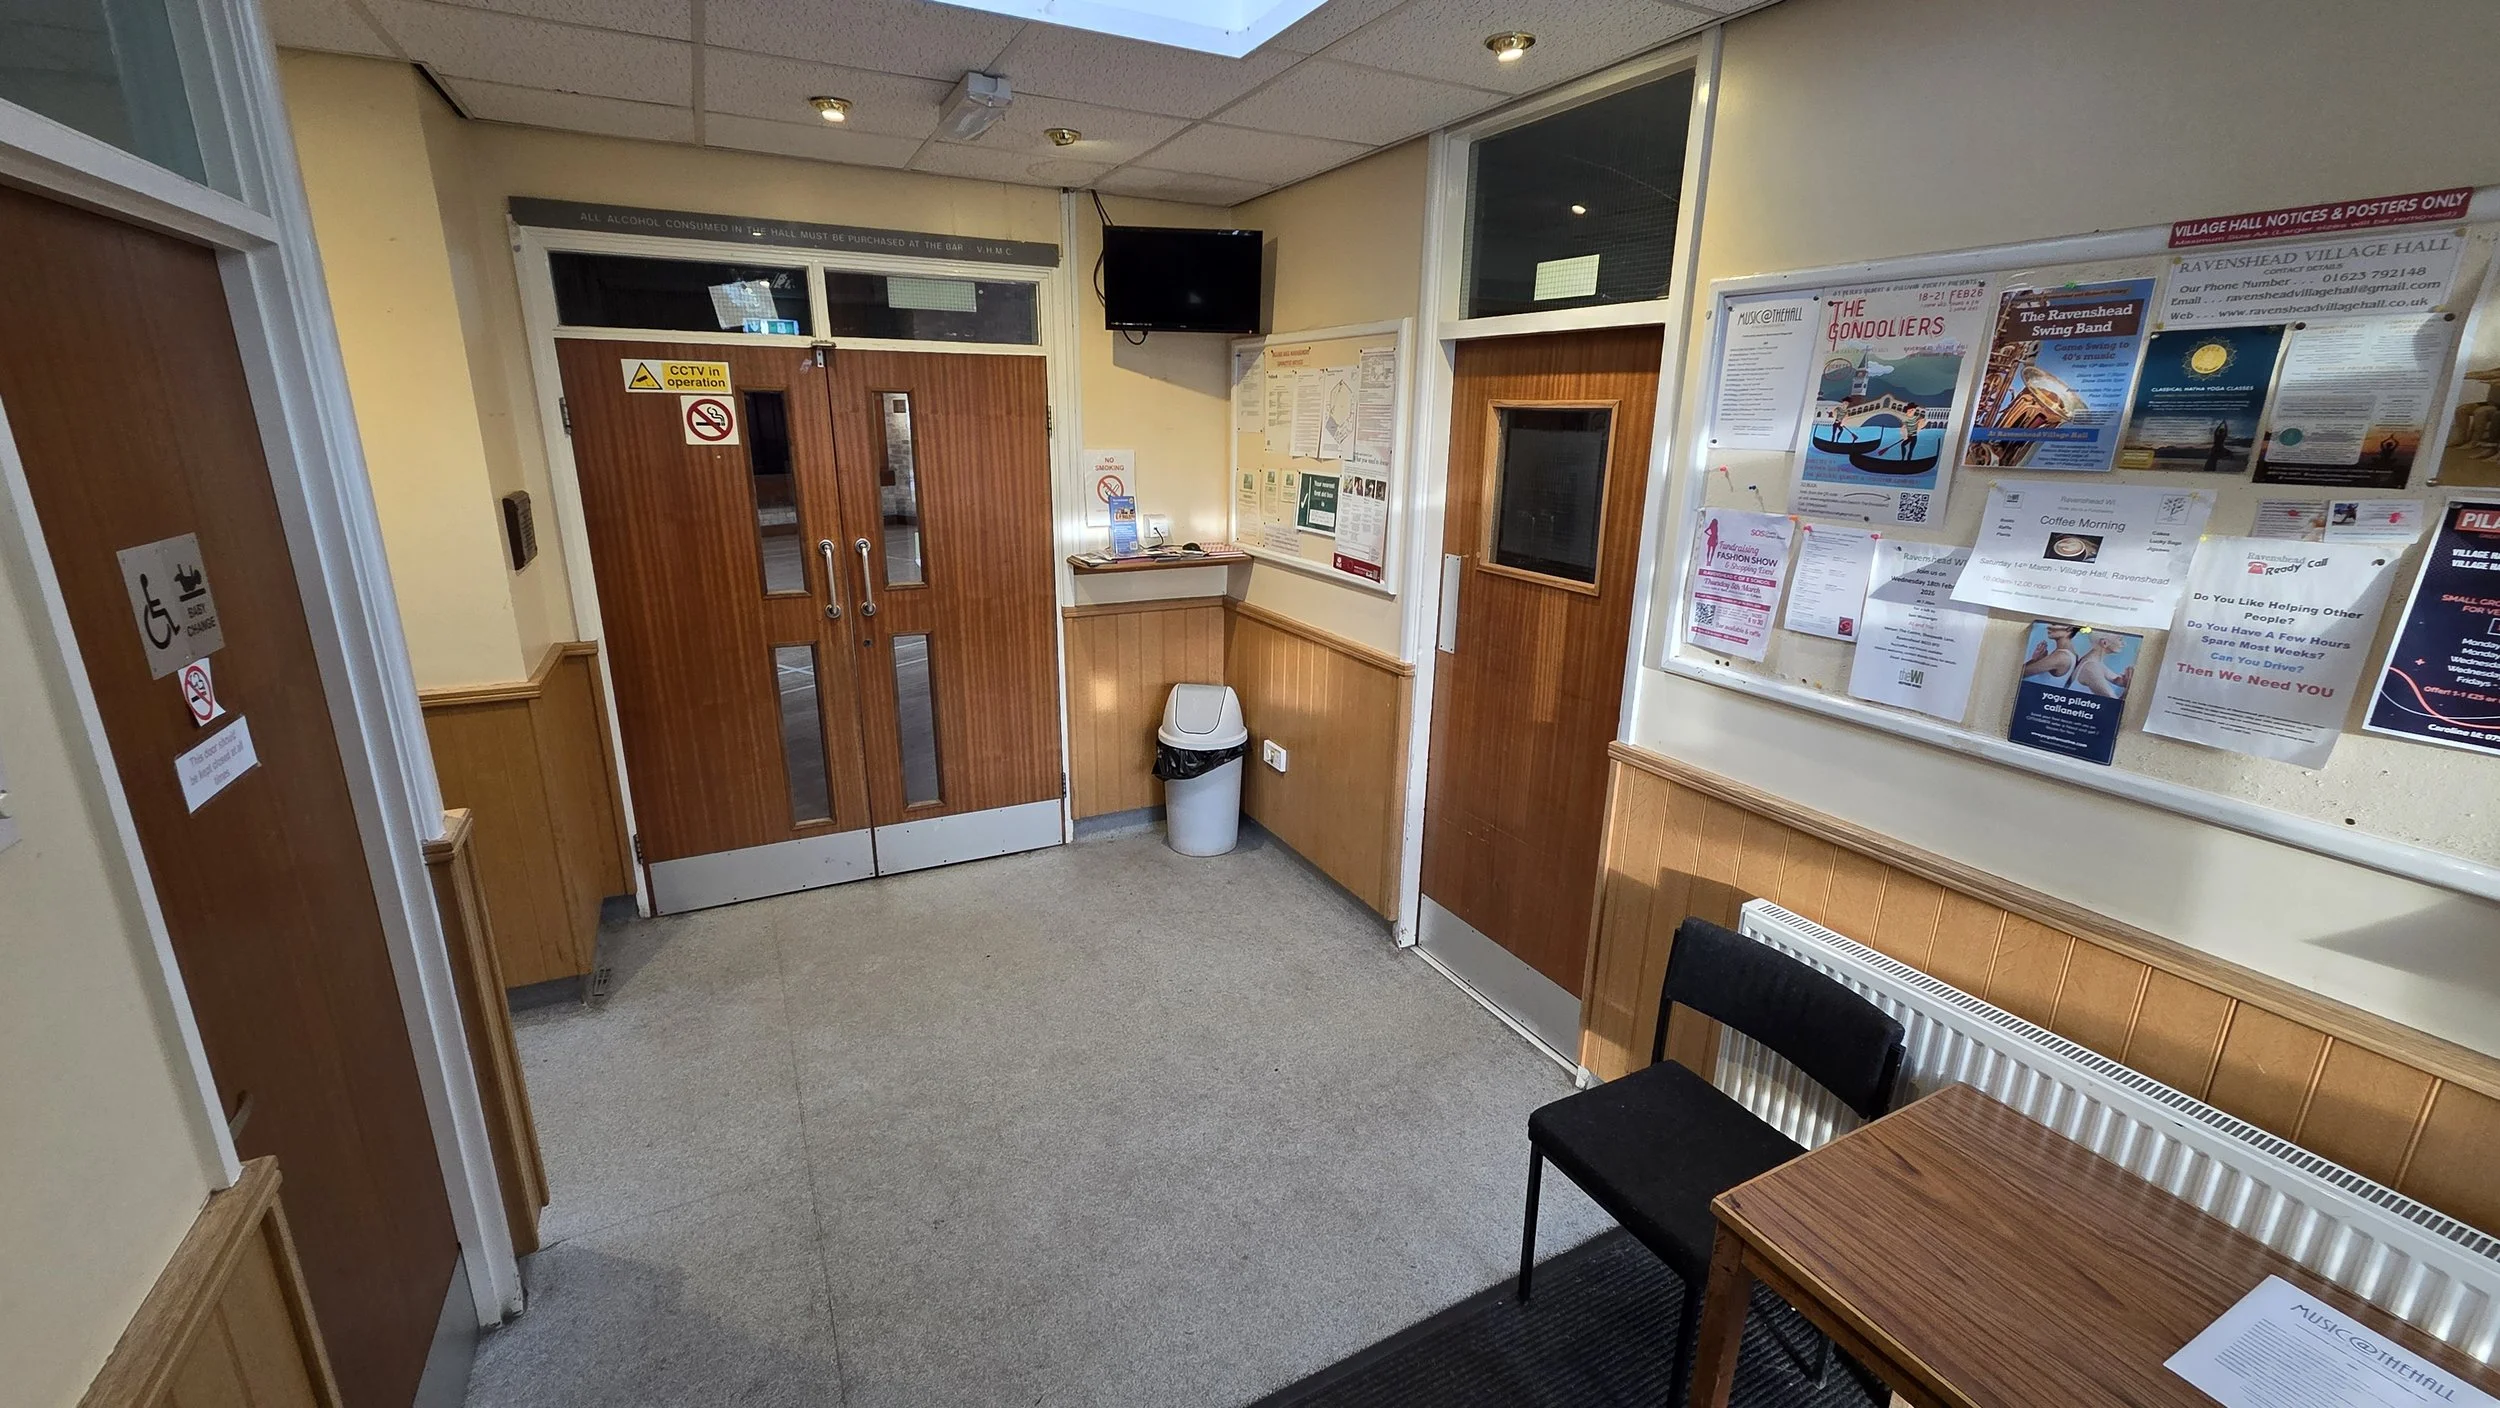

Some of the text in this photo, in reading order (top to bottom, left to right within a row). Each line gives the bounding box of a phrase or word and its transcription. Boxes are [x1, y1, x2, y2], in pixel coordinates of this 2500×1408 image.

[2175, 191, 2468, 238] VILLAGE HALL NOTICES & POSTERS ONLY
[580, 212, 600, 223] ALL
[607, 214, 660, 228] ALCOHOL
[665, 219, 728, 232] CONSUMED
[732, 225, 742, 234] IN
[747, 226, 766, 236] THE
[770, 228, 796, 239] HALL
[800, 230, 828, 241] MUST
[832, 233, 845, 242] BE
[848, 235, 905, 247] PURCHASED
[909, 239, 920, 248] AT
[925, 241, 942, 250] THE
[946, 243, 963, 252] BAR
[2174, 236, 2225, 246] Maximum
[2351, 220, 2369, 228] will
[2373, 217, 2389, 226] be
[2179, 238, 2454, 274] RAVENSHEAD VILLAGE HALL
[2264, 262, 2344, 275] CONTACT DETAILS
[2180, 267, 2426, 294] Our Phone Number 01623 792148
[2170, 280, 2441, 307] Email ravensheadvillagehall@gmail.com
[1831, 299, 1866, 321] THE
[2020, 304, 2133, 323] The Ravenshead
[2170, 297, 2429, 321] Web www.ravensheadvillagehall.co.uk
[1828, 317, 1945, 350] GONDOLIERS
[2032, 321, 2112, 338] Swing Band
[2055, 341, 2130, 352] Come Swing to
[2062, 352, 2116, 361] 40's music
[670, 365, 720, 377] CCTV in
[667, 378, 726, 389] operation
[1095, 464, 1125, 472] SMOKING
[2061, 496, 2104, 506] Ravenshead
[2040, 515, 2126, 533] Coffee Morning
[1751, 529, 1765, 537] SOS
[1719, 541, 1760, 556] Fundraising
[2452, 549, 2490, 558] VILLAGE
[1717, 552, 1778, 567] FASHION SHOW
[1904, 552, 1952, 565] Ravenshead
[2247, 552, 2306, 565] Ravenshead
[2265, 557, 2328, 576] Ready Call
[2451, 560, 2489, 570] VILLAGE
[1729, 562, 1758, 574] Shopping
[1758, 567, 1774, 576] Event
[1980, 558, 2012, 569] Saturday
[2029, 564, 2052, 572] March
[2060, 566, 2088, 577] Village
[2090, 568, 2108, 579] Hall,
[2111, 572, 2170, 585] Ravenshead
[1704, 578, 1730, 589] Thursday
[1891, 576, 1926, 587] Wednesday
[2193, 592, 2364, 620] Do You Like Helping Other
[2441, 594, 2477, 605] SMALL
[187, 603, 206, 619] BABY
[2462, 605, 2485, 614] FOR
[186, 616, 217, 638] CHANGE
[2244, 612, 2295, 626] People?
[2187, 620, 2351, 650] Do You Have A Few Hours
[2201, 635, 2325, 660] Spare Most Weeks?
[2210, 652, 2304, 674] Can You Drive?
[2177, 663, 2336, 698] Then We Need YOU
[2456, 676, 2491, 687] Fridays
[2042, 692, 2101, 710] yoga pilates
[2044, 704, 2094, 720] callanetics
[2428, 724, 2469, 737] Caroline
[2290, 1304, 2456, 1402] MUSIC@THEHALL
